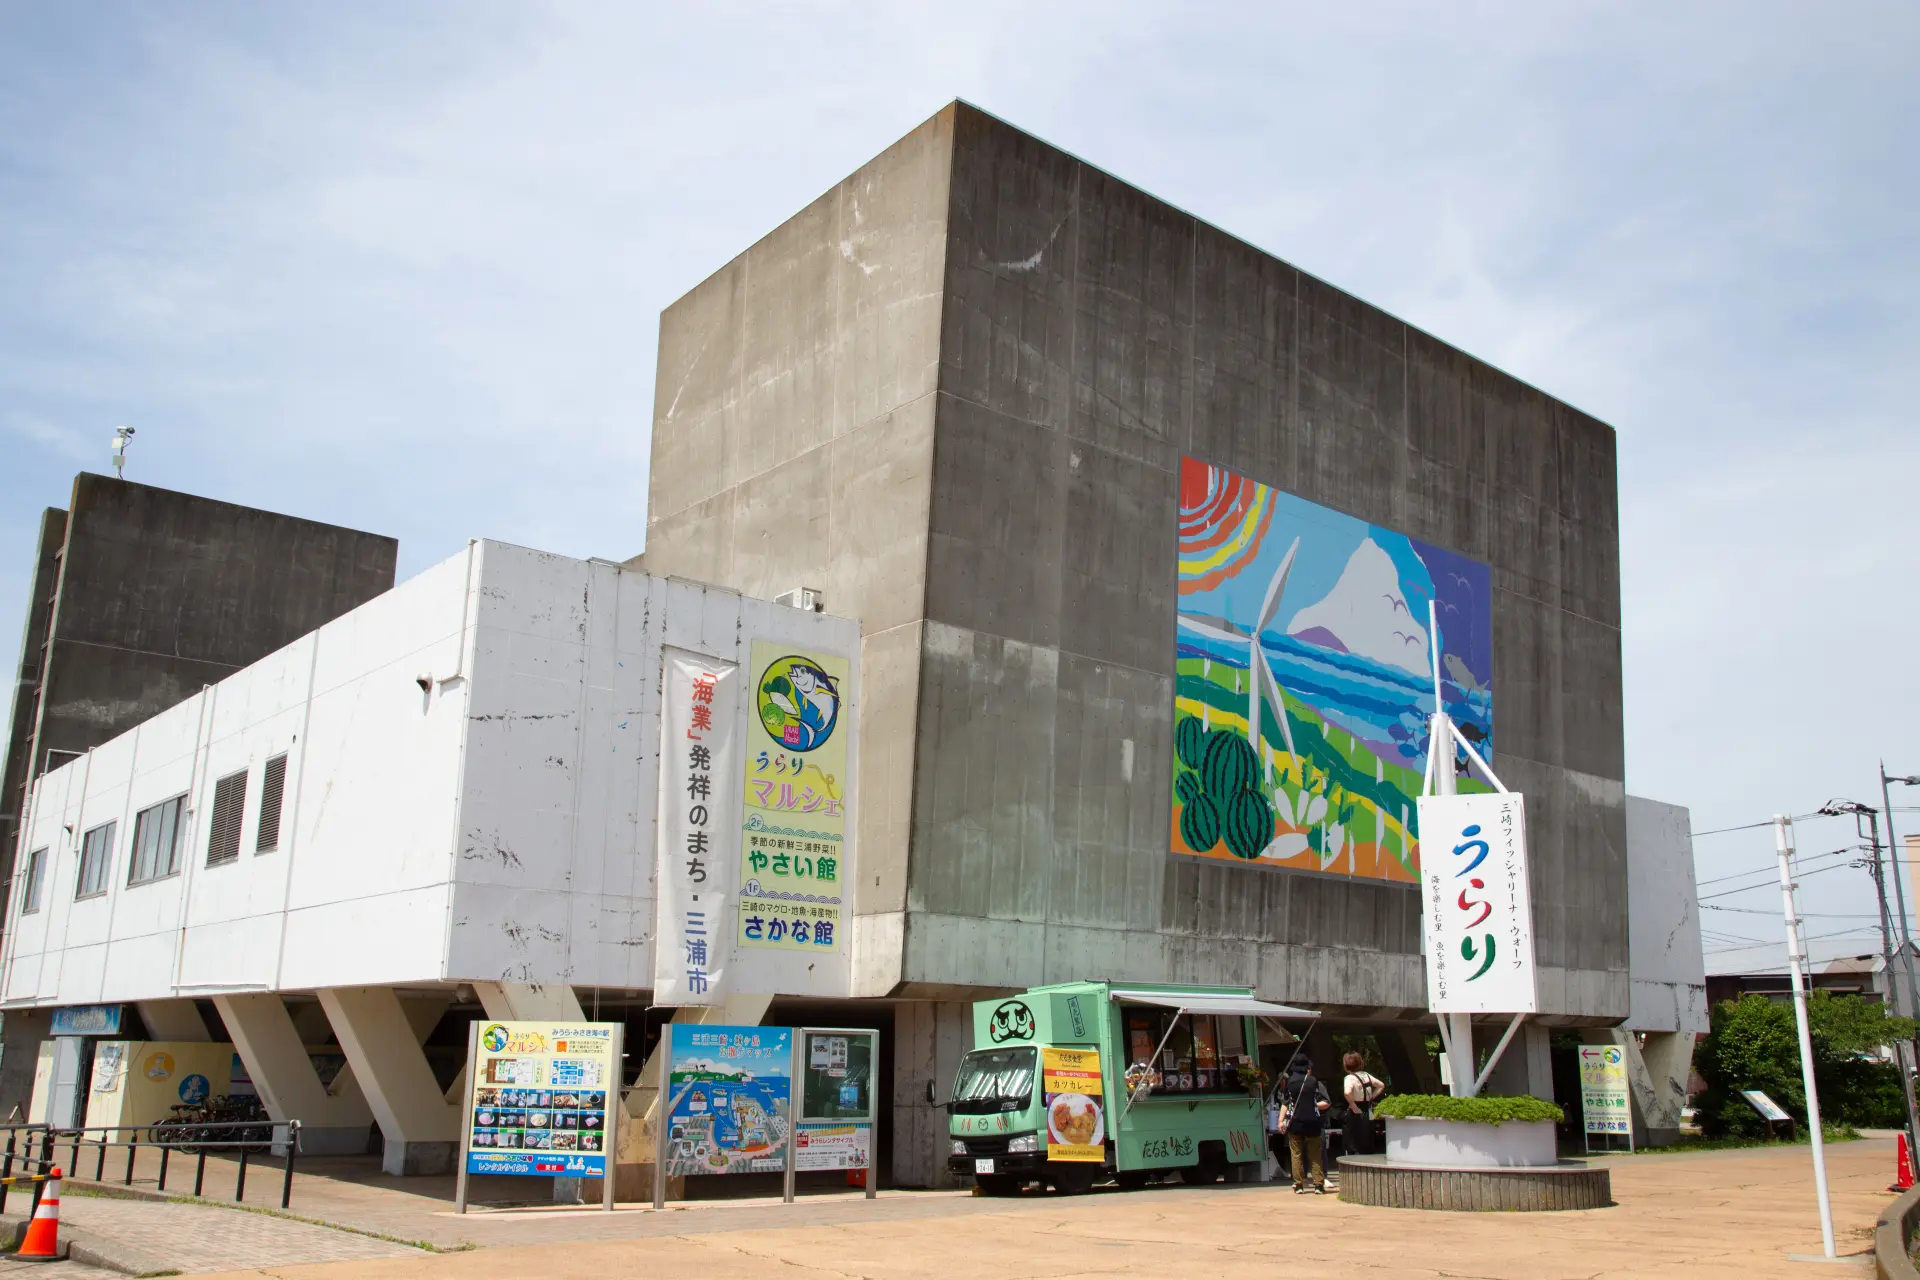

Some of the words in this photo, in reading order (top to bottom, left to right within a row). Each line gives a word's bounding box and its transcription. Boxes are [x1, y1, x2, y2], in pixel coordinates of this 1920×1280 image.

[756, 751, 804, 776] うらり
[751, 777, 841, 818] マルシェ
[685, 672, 719, 995] 「海業」発祥のまち・三浦市
[750, 816, 761, 828] 2F
[748, 850, 837, 881] やさい館
[747, 882, 758, 894] 1F
[1501, 803, 1522, 969] 三崎フィッシャリーナ・ウォーフ
[1452, 824, 1496, 982] うらり
[744, 915, 834, 946] さかな館
[1053, 1079, 1092, 1090] カツカレー
[1585, 1098, 1625, 1107] やさい館
[1587, 1121, 1628, 1131] さかな館
